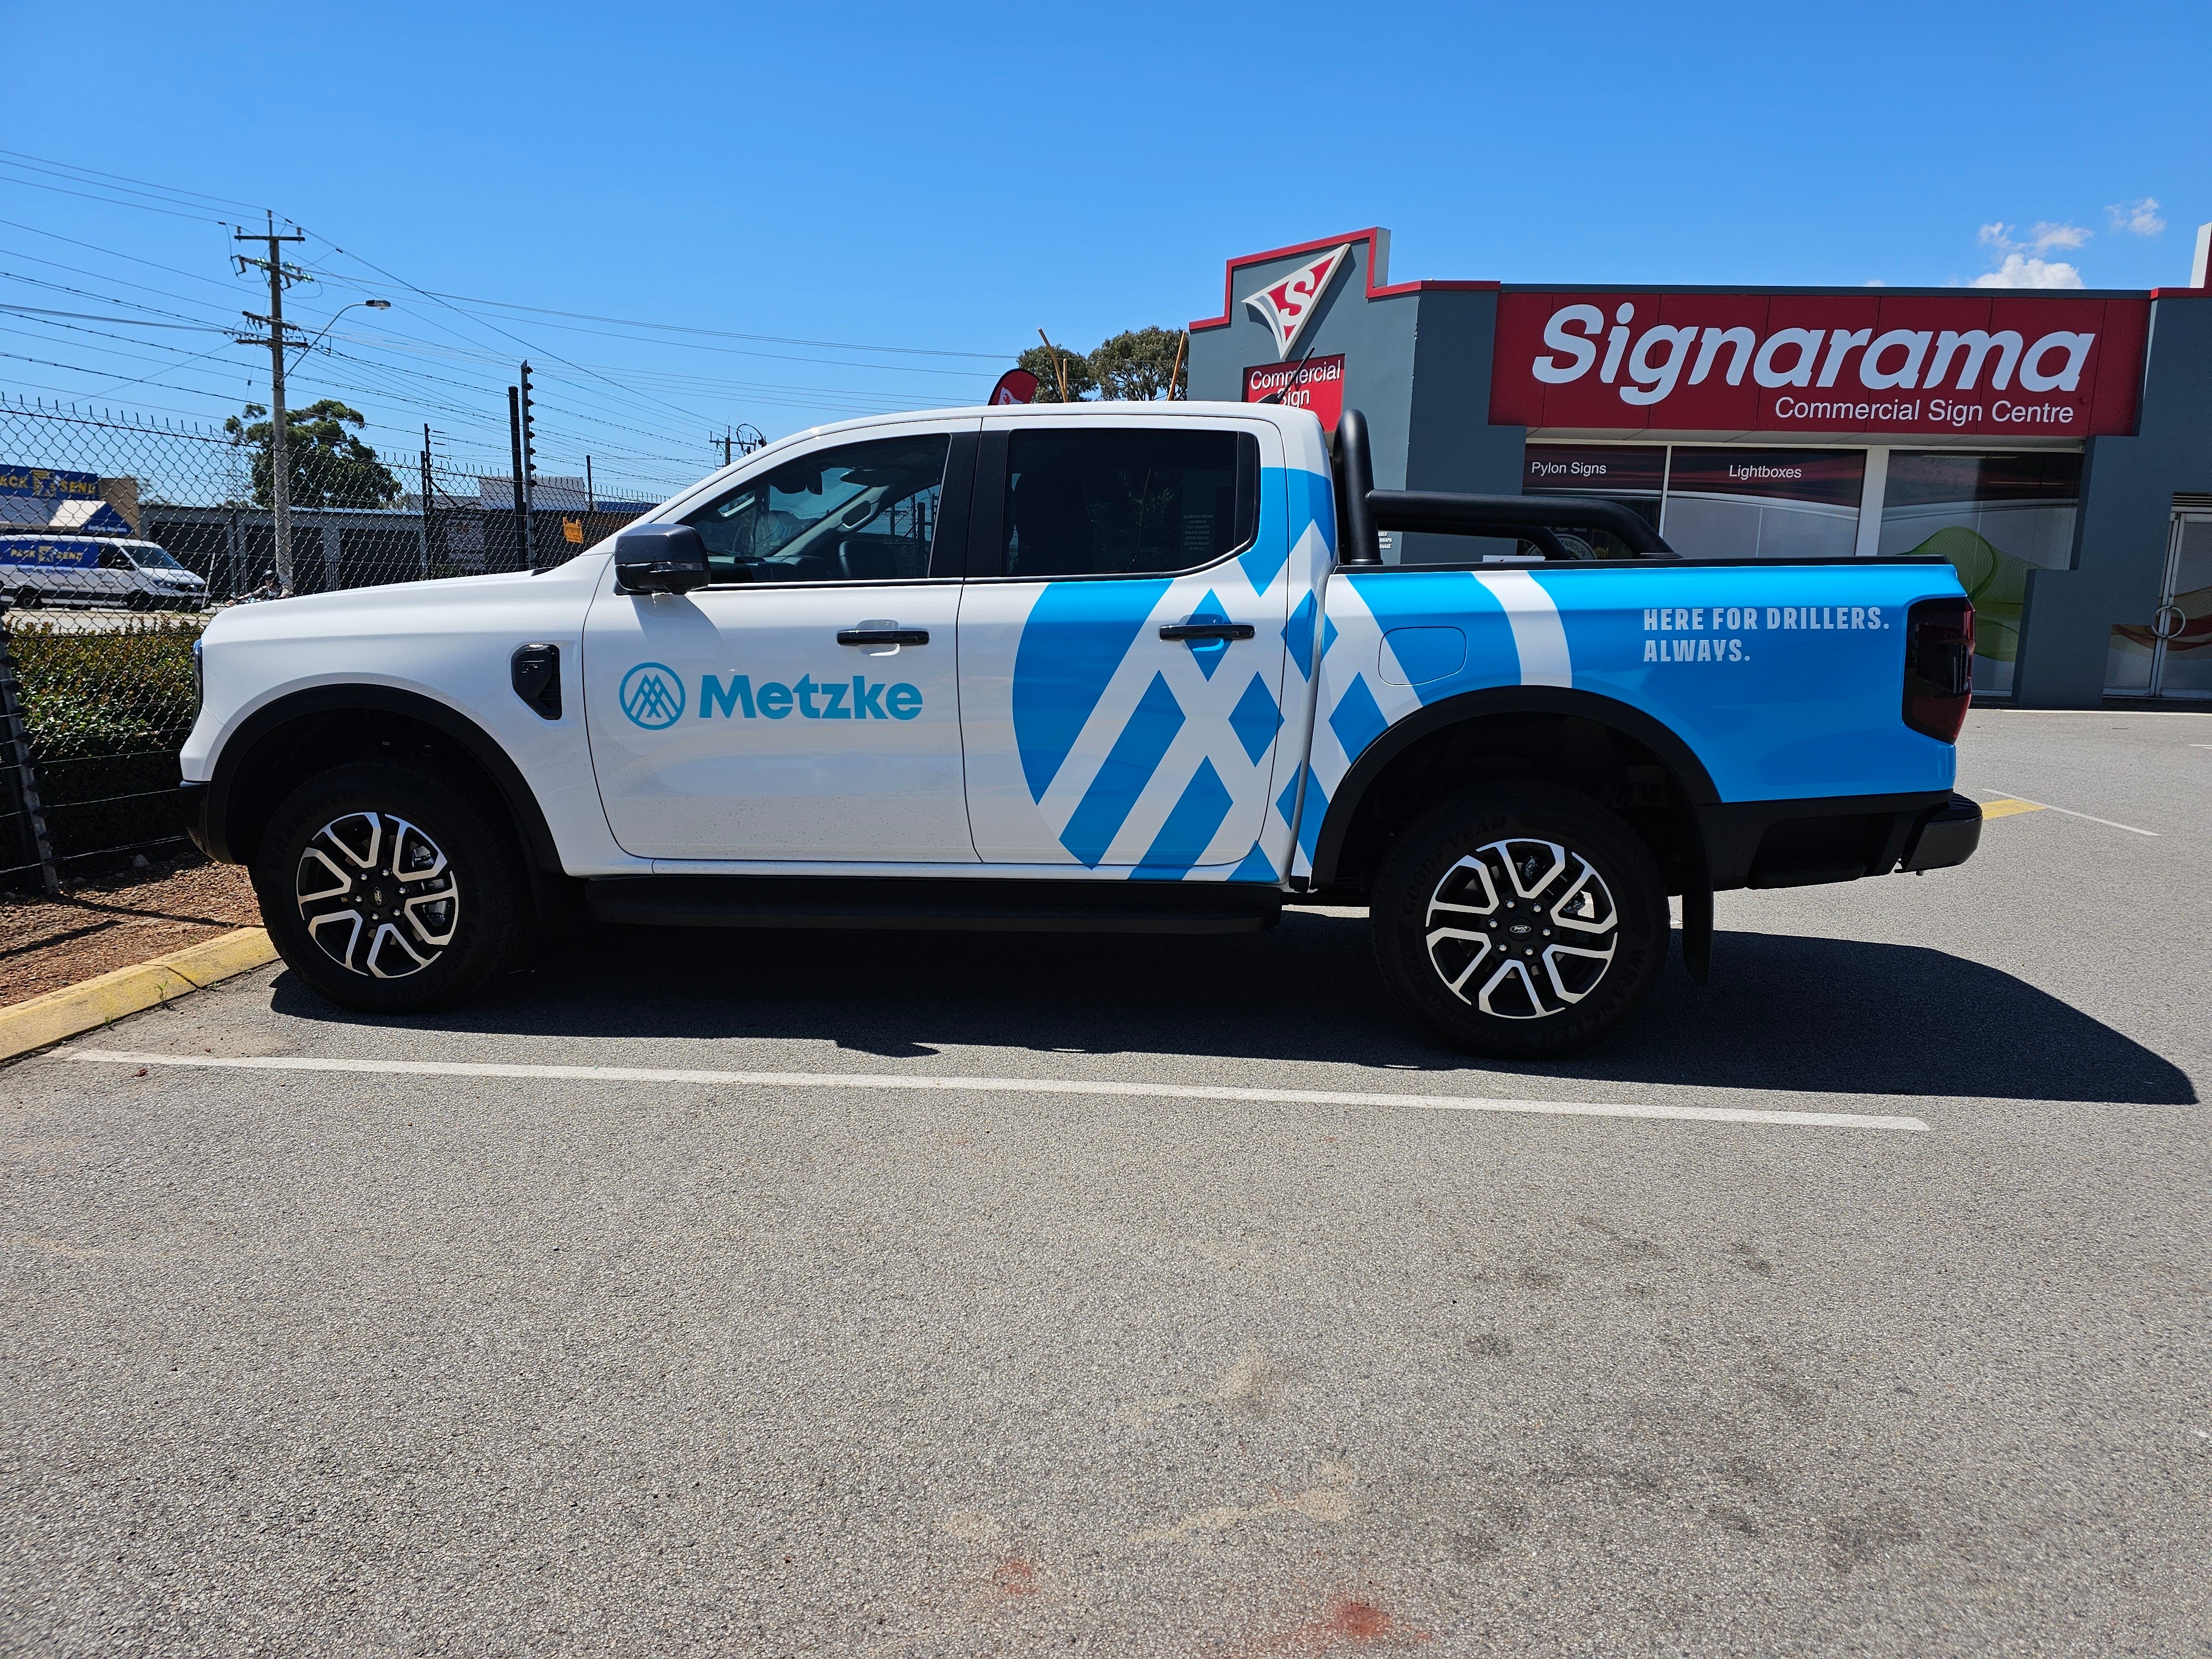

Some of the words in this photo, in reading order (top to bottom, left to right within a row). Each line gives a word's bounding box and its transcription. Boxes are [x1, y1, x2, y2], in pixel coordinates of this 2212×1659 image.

[1531, 301, 2096, 406] Signarama
[1250, 359, 1340, 390] Commercial
[1277, 387, 1310, 408] Sign
[1775, 397, 1920, 420] Commercial
[1928, 399, 1983, 426] Sign
[1992, 400, 2074, 423] Centre
[1531, 462, 1567, 476] Pylon
[1571, 462, 1606, 477] Signs
[1729, 465, 1802, 480] Lightboxes
[11, 549, 36, 558] PACK
[1644, 608, 1704, 630] HERE
[1713, 607, 1758, 630] FOR
[1767, 607, 1890, 630] DRILLERS.
[1644, 639, 1751, 662] ALWAYS.
[699, 673, 924, 721] Metzke
